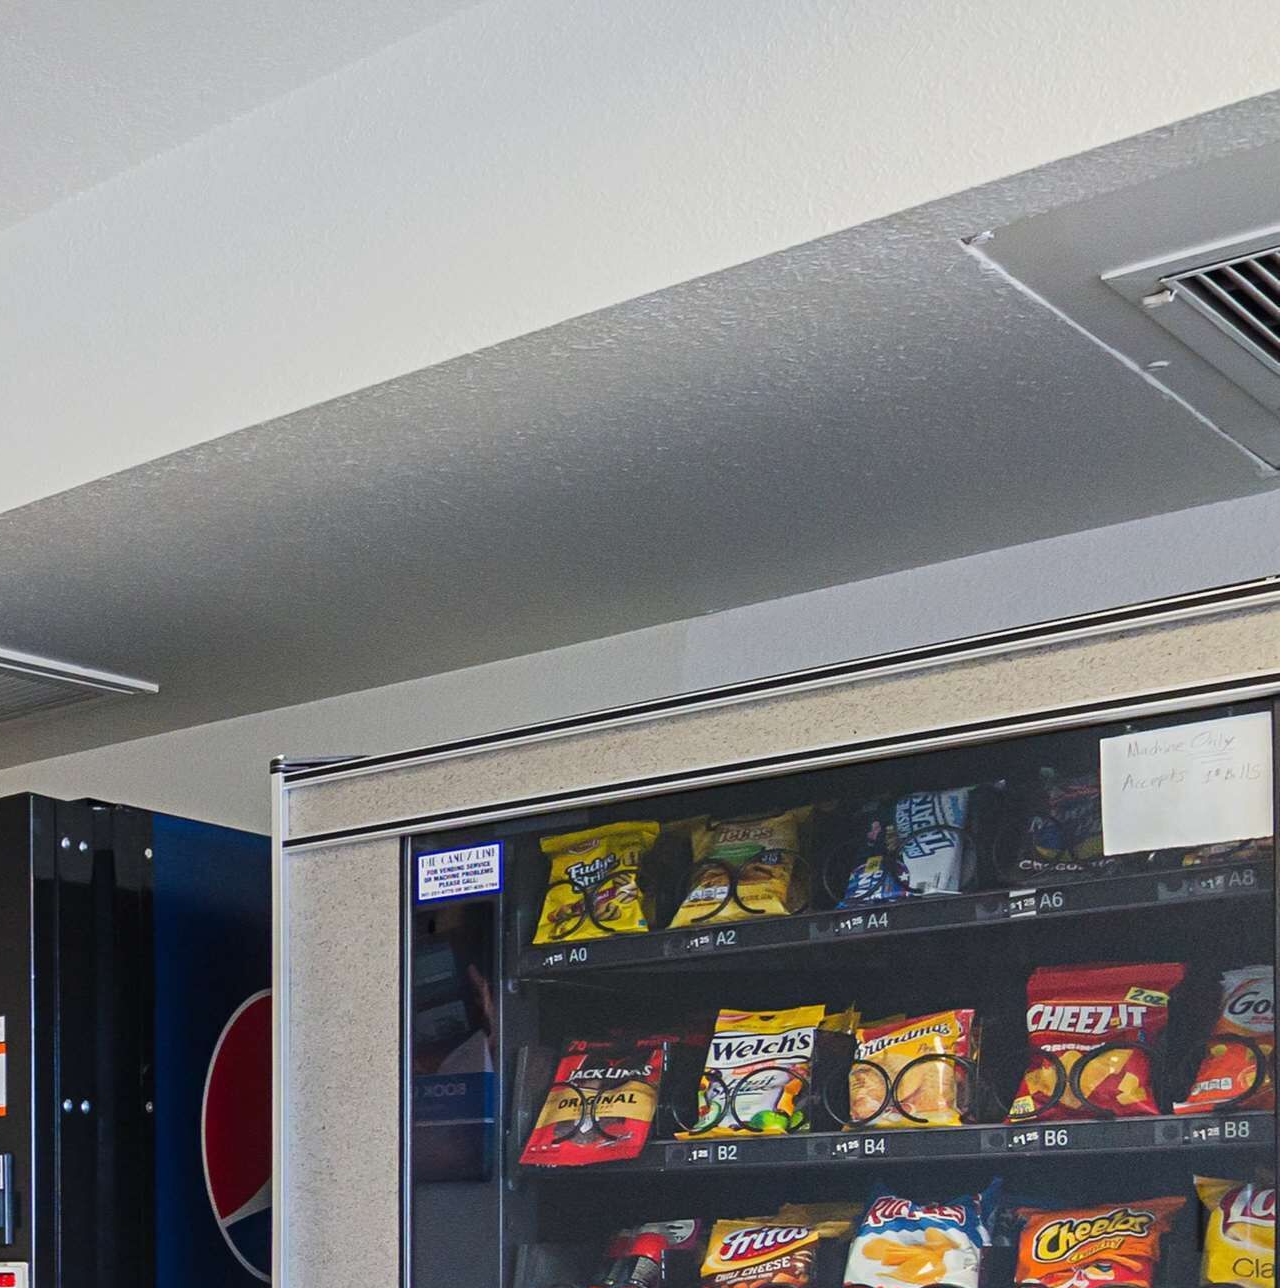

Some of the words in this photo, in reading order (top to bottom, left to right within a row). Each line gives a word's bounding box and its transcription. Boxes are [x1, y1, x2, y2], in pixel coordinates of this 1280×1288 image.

[1229, 870, 1255, 886] A8
[1040, 892, 1063, 908] A6
[867, 913, 888, 928] A4
[715, 930, 736, 946] A2
[569, 948, 588, 963] A0
[713, 1032, 811, 1061] Welch's
[568, 1068, 602, 1083] JACK
[1044, 1129, 1068, 1146] B6
[1224, 1122, 1250, 1139] B8
[718, 1146, 738, 1161] B2
[864, 1139, 886, 1155] B4
[1036, 1208, 1153, 1261] Cheetos
[721, 1226, 810, 1260] Fritos
[741, 1256, 792, 1277] CHEESE
